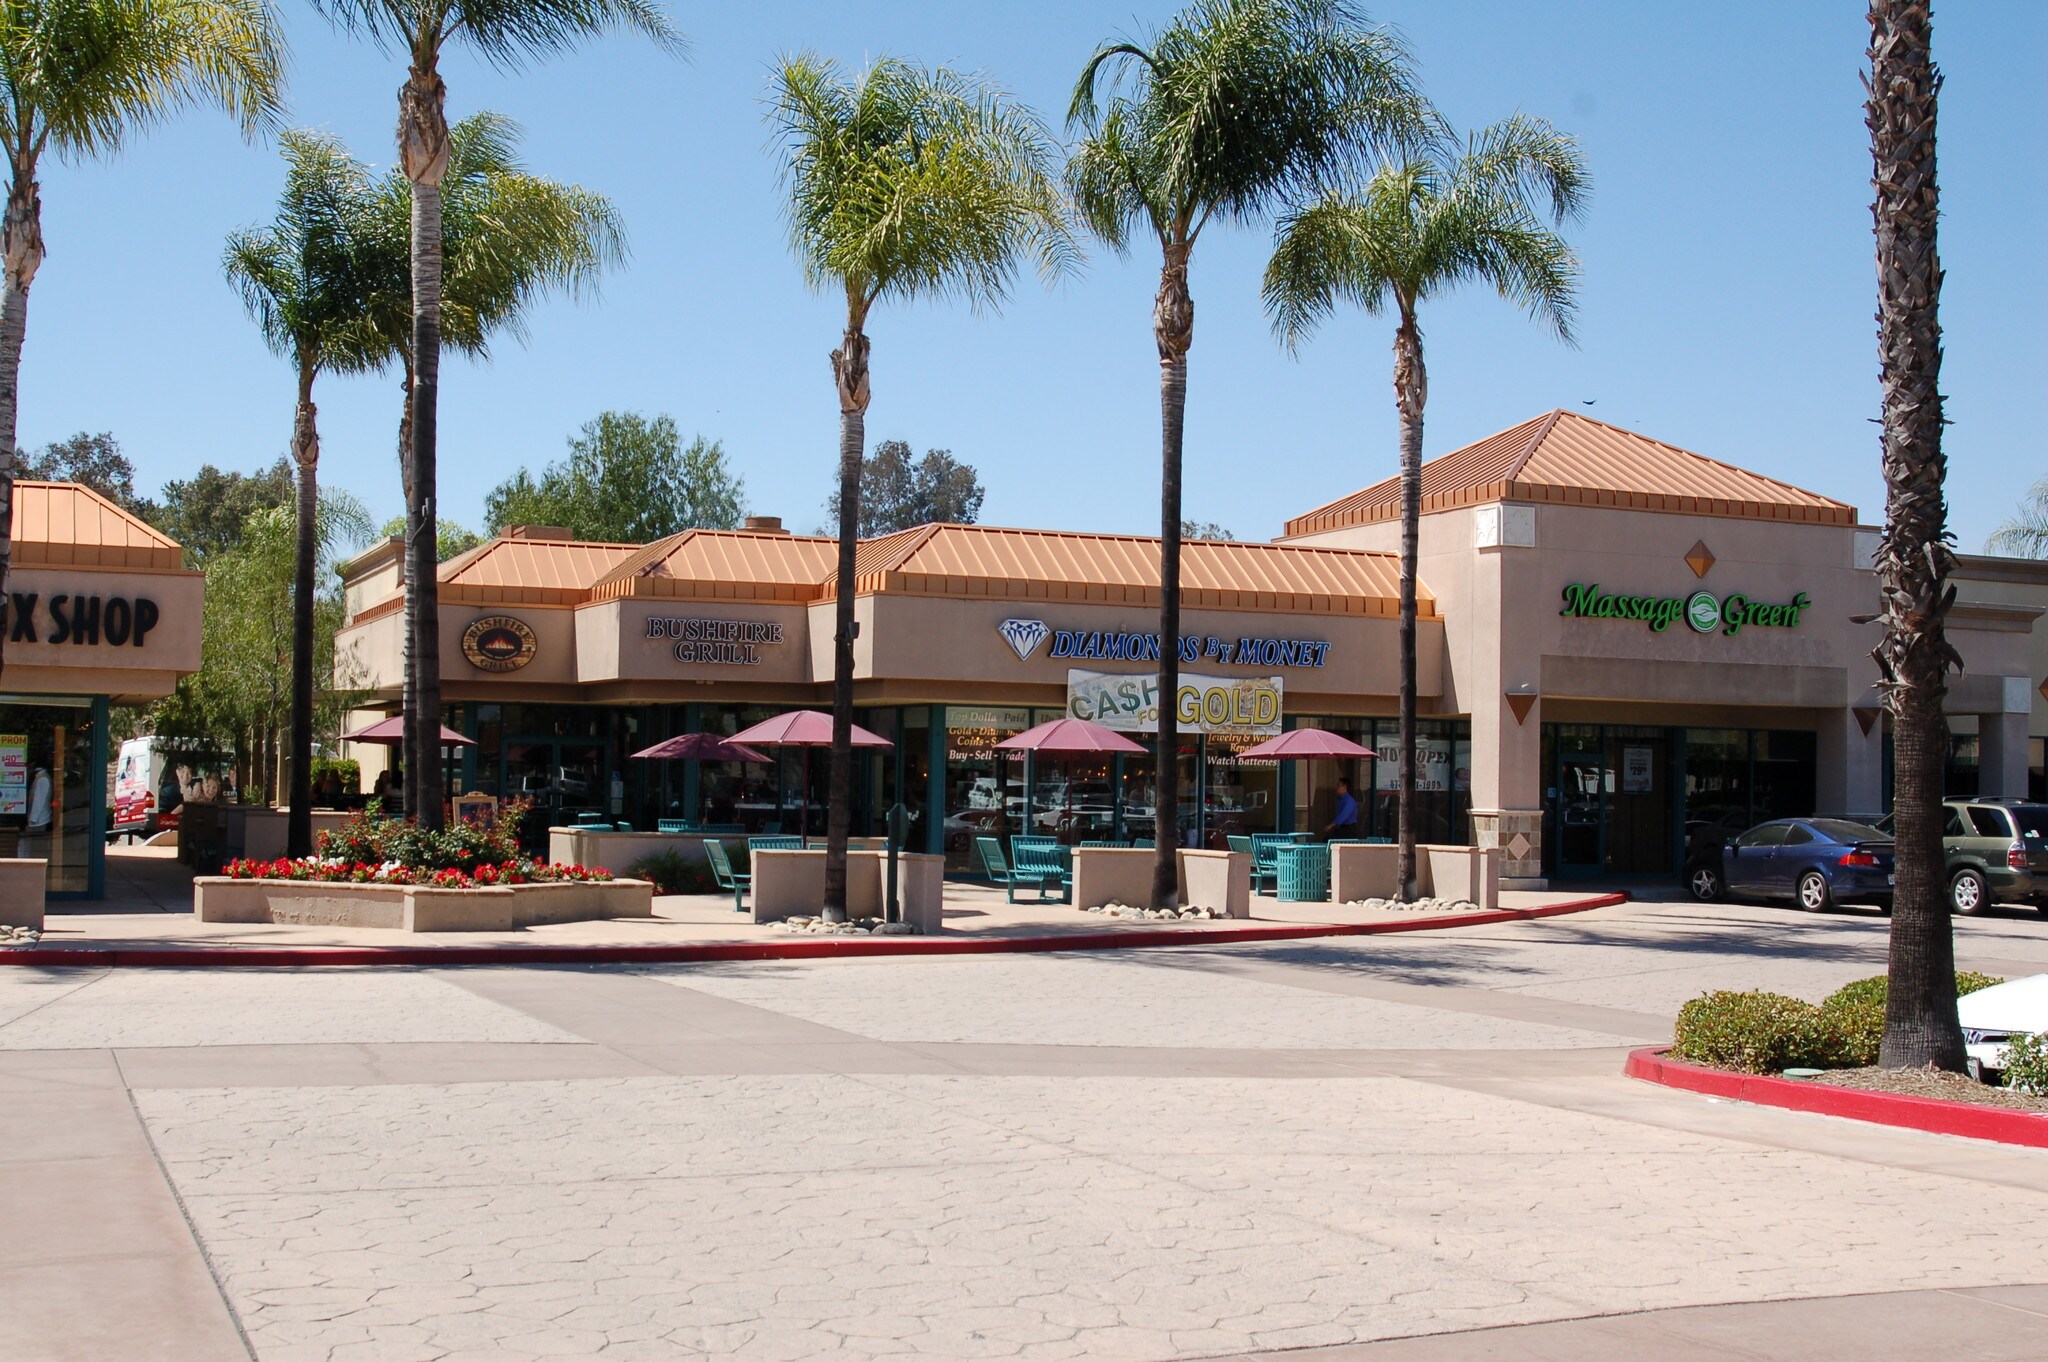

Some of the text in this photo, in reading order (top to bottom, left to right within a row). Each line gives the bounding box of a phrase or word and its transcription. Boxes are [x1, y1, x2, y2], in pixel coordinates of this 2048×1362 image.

[1561, 583, 1801, 637] Massage Green
[11, 593, 159, 647] X SHOP
[468, 618, 531, 638] BUSHFIRE
[647, 617, 784, 644] BUSHFIRE
[674, 641, 761, 665] GRILL
[1051, 631, 1200, 664] DIAMONS
[1236, 638, 1332, 669] MONET
[1177, 685, 1279, 725] GOLD
[970, 711, 998, 722] Dolla
[1004, 712, 1026, 723] Paid
[1137, 707, 1160, 726] FO
[949, 727, 971, 736] Gold
[1208, 733, 1241, 744] Jewelry
[1253, 733, 1274, 743] Watc
[1, 735, 27, 745] PROM
[957, 736, 984, 747] Coins
[1578, 740, 1583, 750] 3
[949, 750, 968, 762] Buy
[974, 750, 993, 760] Sell
[1000, 751, 1026, 761] Trade
[1207, 756, 1278, 766] Watch Batteries
[1379, 747, 1401, 763] NO
